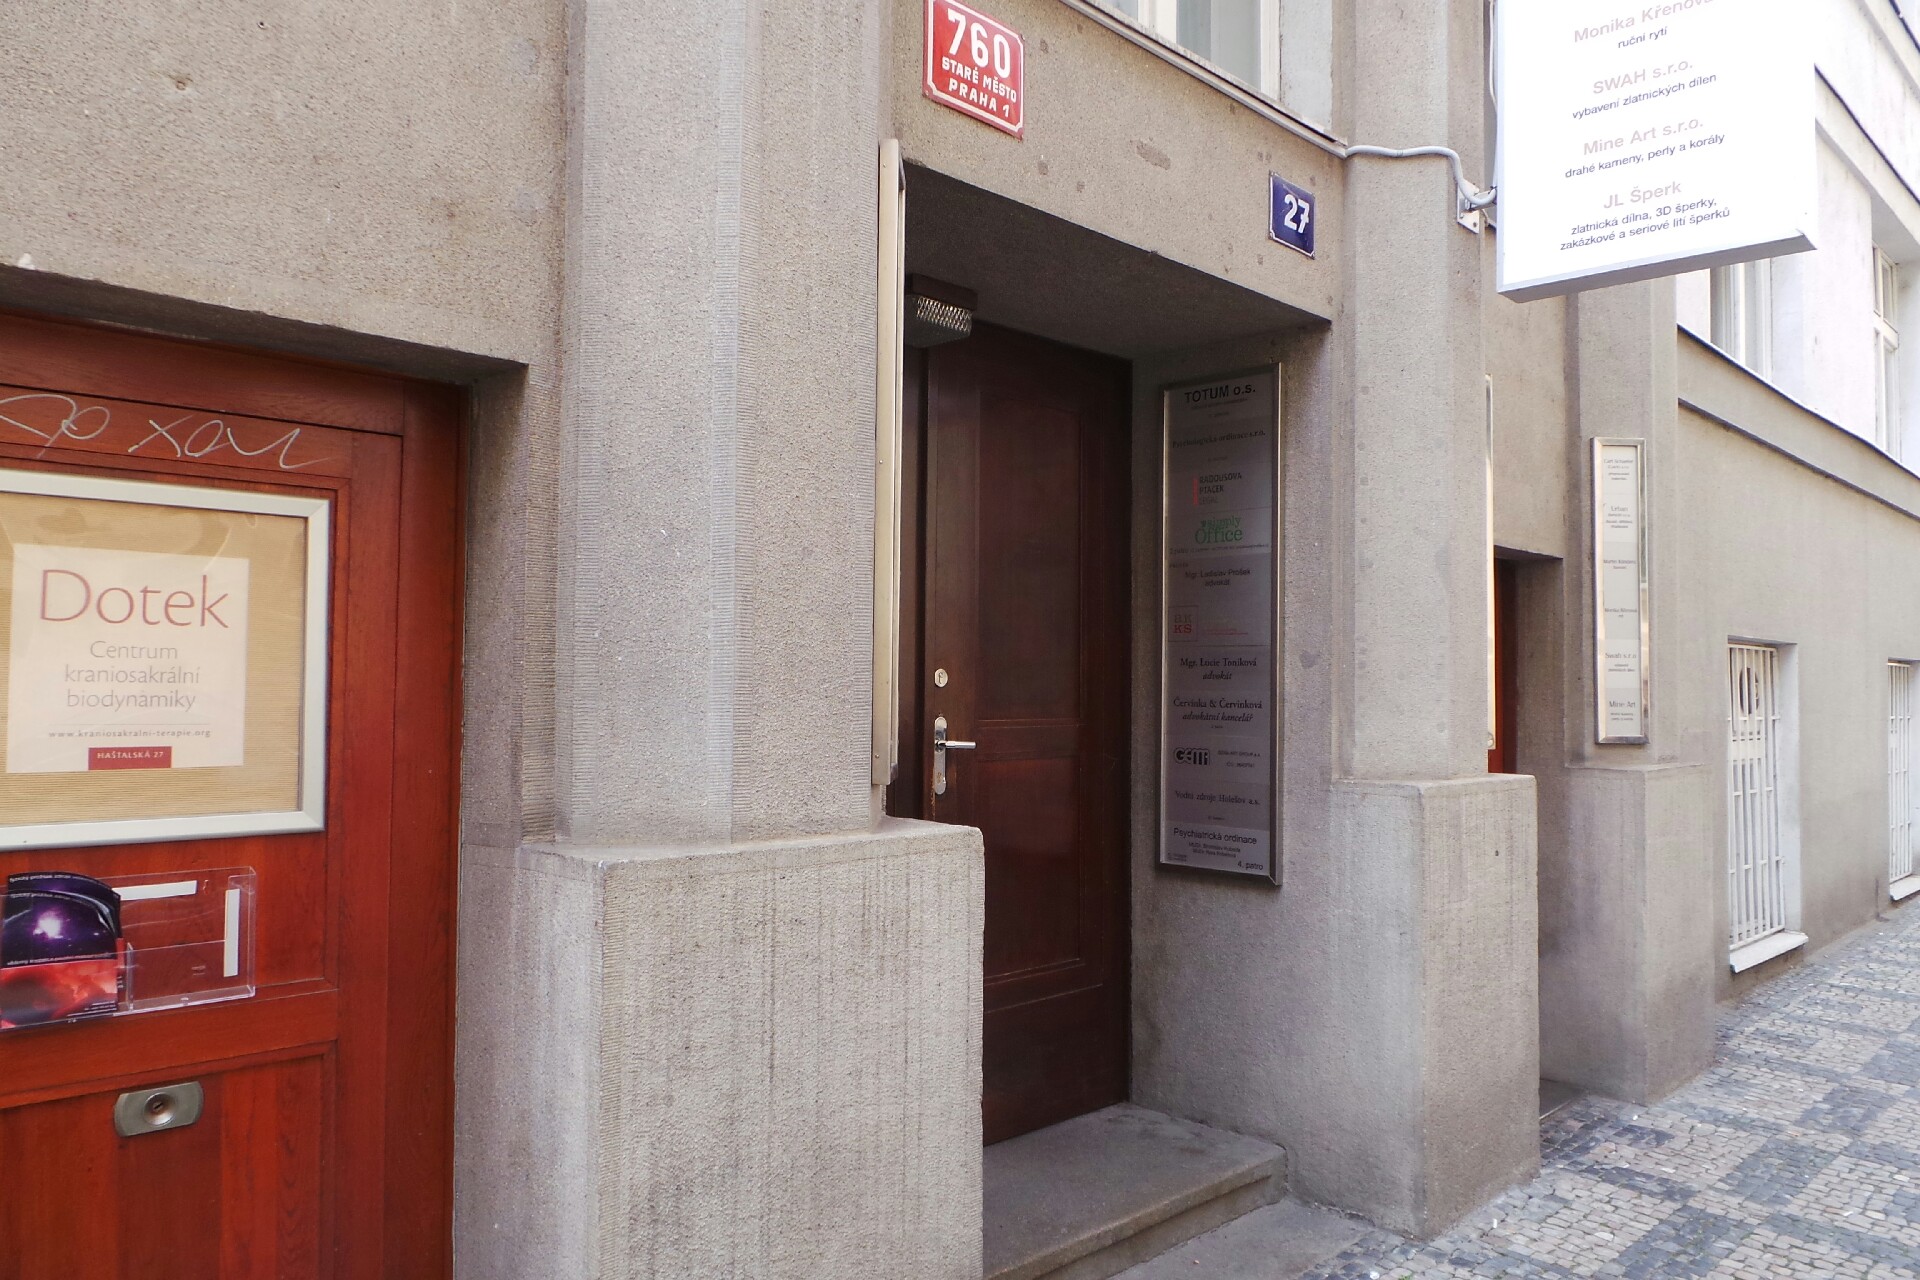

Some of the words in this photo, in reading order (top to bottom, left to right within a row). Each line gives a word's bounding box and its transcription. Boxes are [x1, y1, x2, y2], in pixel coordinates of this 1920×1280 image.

[1574, 16, 1635, 43] Monika
[947, 8, 1011, 79] 760
[941, 56, 979, 84] STARÉ
[982, 75, 1017, 103] MĚSTO
[1593, 69, 1647, 95] SWAH
[1652, 60, 1693, 79] s.r.o.
[948, 78, 998, 112] PRAHA
[1002, 104, 1010, 118] 1
[1572, 98, 1620, 120] vybavení
[1623, 81, 1685, 106] zlatnických
[1688, 72, 1717, 88] dílen
[1583, 136, 1624, 156] Mine
[1630, 127, 1656, 145] Art
[1662, 119, 1704, 137] s.r.o.
[1565, 163, 1596, 179] drahé
[1598, 152, 1645, 172] kameny,
[1647, 145, 1676, 161] perly
[1679, 143, 1687, 152] a
[1689, 133, 1726, 150] korály
[1603, 194, 1625, 210] JL
[1630, 181, 1682, 207] Šperk
[1284, 194, 1310, 234] 27
[1571, 217, 1619, 236] zlatnická
[1622, 211, 1652, 226] dílna,
[1655, 205, 1672, 217] 3D
[1674, 197, 1718, 216] šperky,
[1560, 230, 1616, 251] zakázkové
[1618, 231, 1626, 239] a
[1629, 220, 1670, 237] seriové
[1673, 215, 1687, 228] lití
[1689, 206, 1731, 228] šperků
[1184, 385, 1230, 403] TOTUM
[1233, 383, 1256, 396] o.s.
[1194, 528, 1243, 545] Office
[40, 568, 230, 629] Dotek
[90, 640, 178, 659] Centrum
[1200, 657, 1220, 667] Lucie
[64, 664, 200, 685] kraniosakrální
[67, 689, 196, 712] biodynamiky
[1210, 700, 1217, 708] &
[1219, 697, 1263, 709] Červinková
[1220, 712, 1253, 722] kancelář
[48, 729, 212, 739] www.kraniosakralni-terapie.org
[97, 749, 151, 760] HAŠTALSKÁ
[153, 750, 164, 759] 27
[1173, 827, 1223, 842] Psychiatrická
[1224, 833, 1258, 845] ordinace
[1237, 860, 1244, 868] 4.
[1245, 862, 1264, 871] patro
